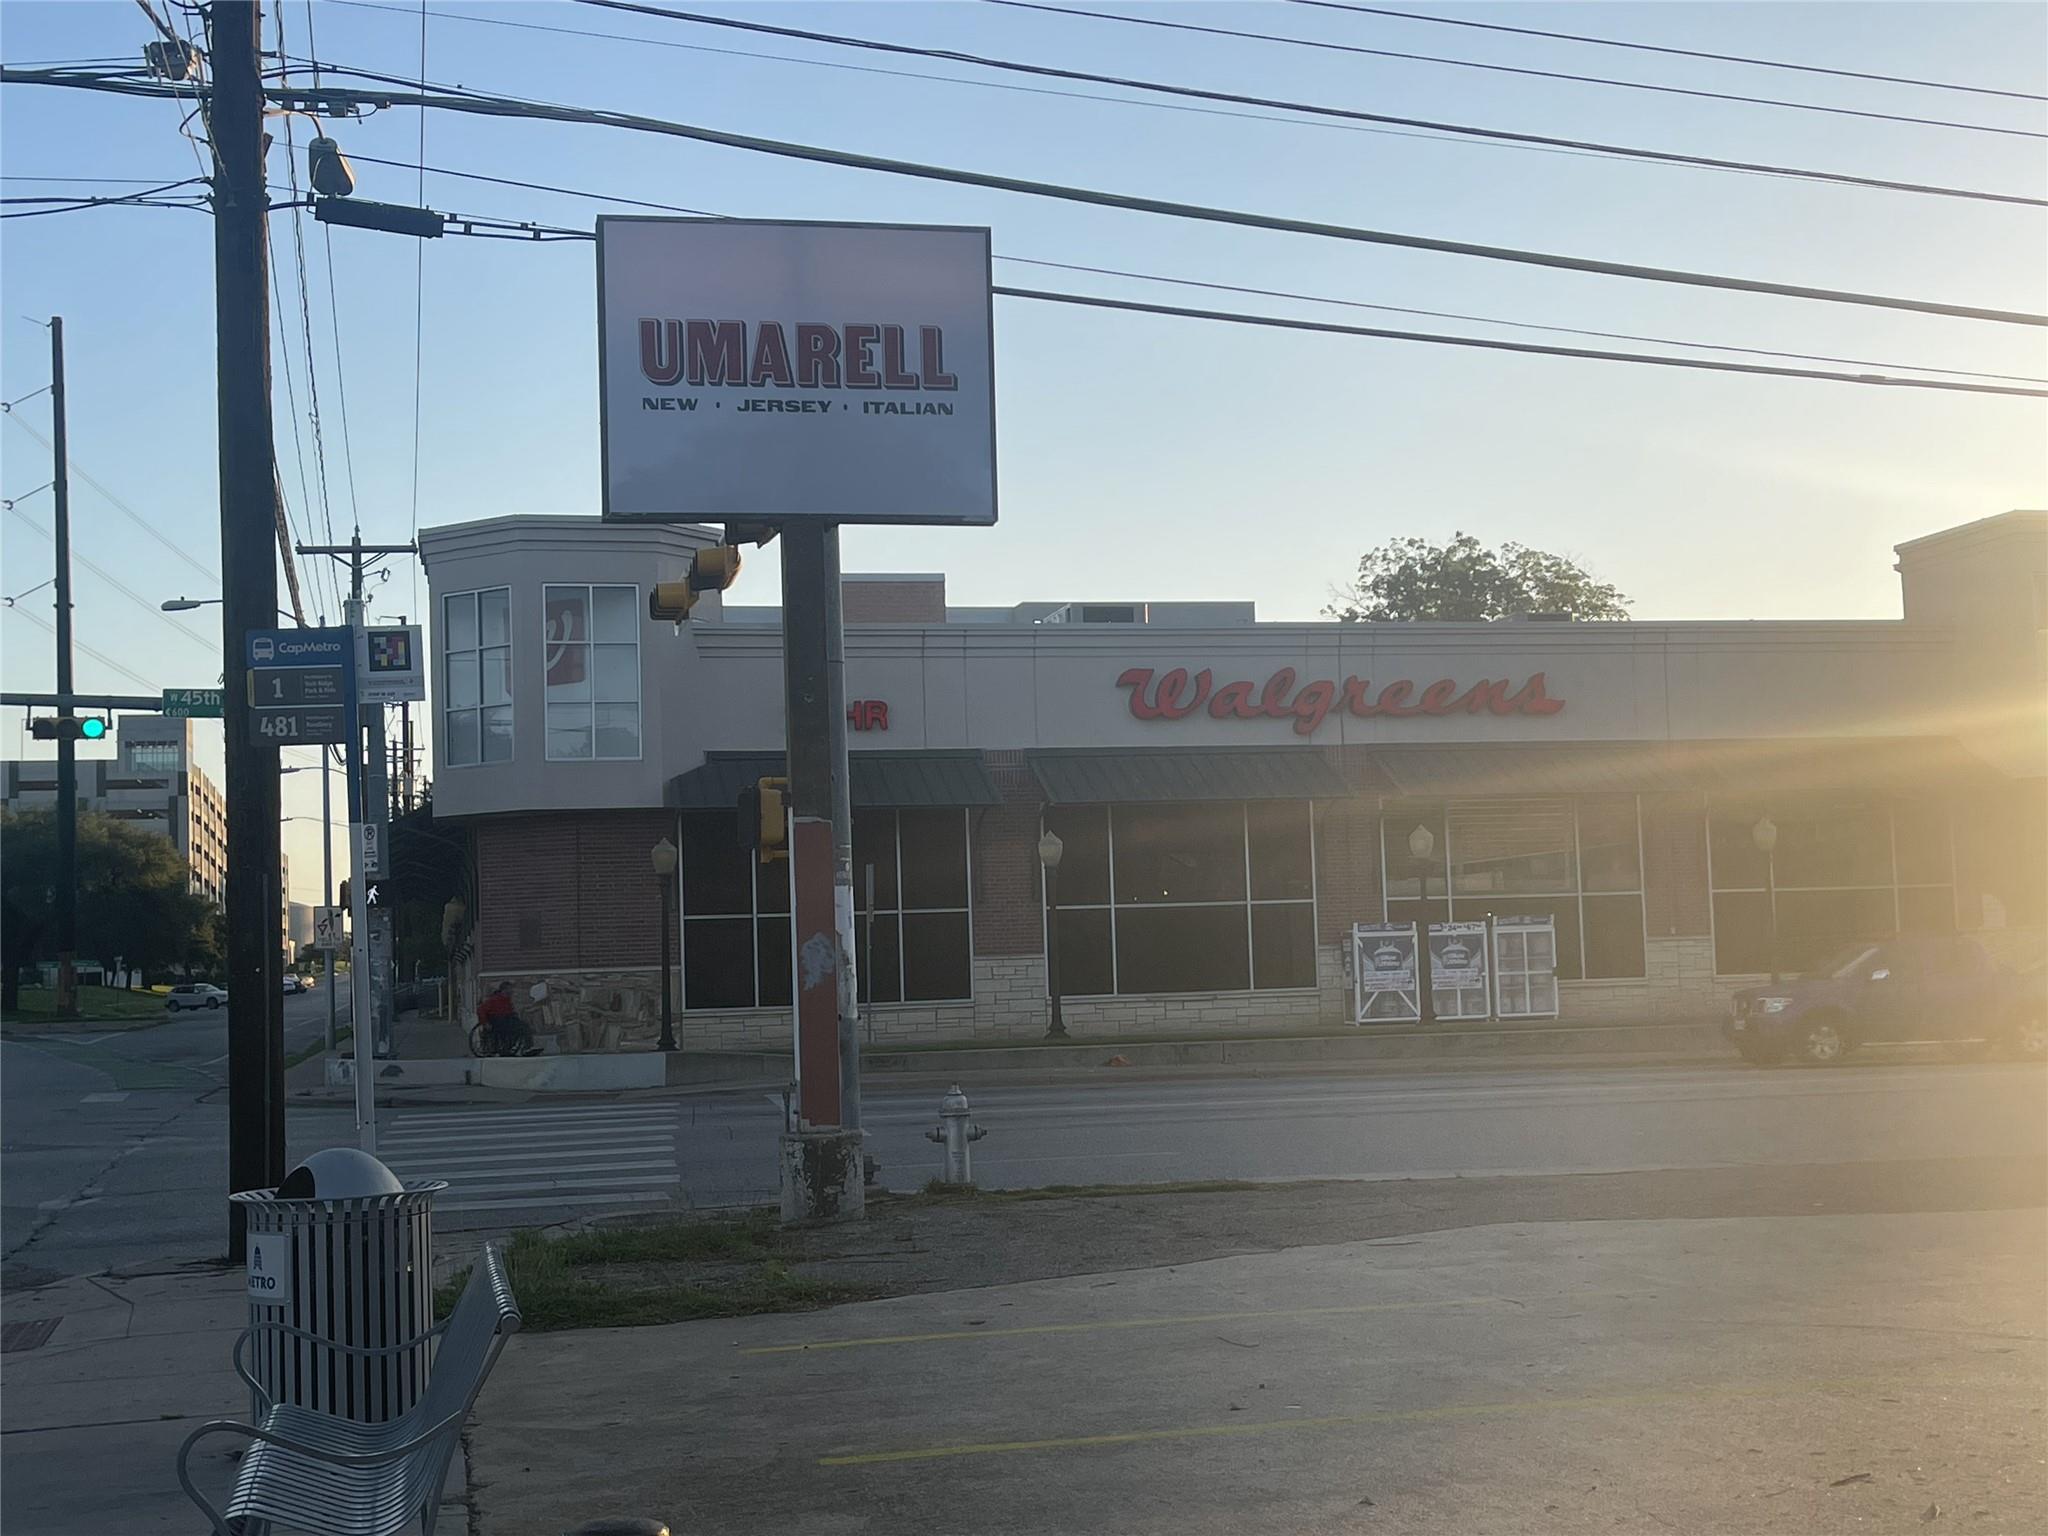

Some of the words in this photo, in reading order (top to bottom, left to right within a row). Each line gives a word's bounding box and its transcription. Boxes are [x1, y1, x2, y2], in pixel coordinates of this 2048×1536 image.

[638, 317, 959, 392] UMARELL
[642, 397, 698, 411] NEW
[736, 398, 832, 413] JERSEY
[863, 400, 954, 416] ITALIAN
[279, 641, 341, 656] CapMetro
[180, 690, 220, 705] 45th
[271, 677, 284, 699] 1
[1115, 666, 1567, 737] Walgreens
[260, 715, 299, 737] 481
